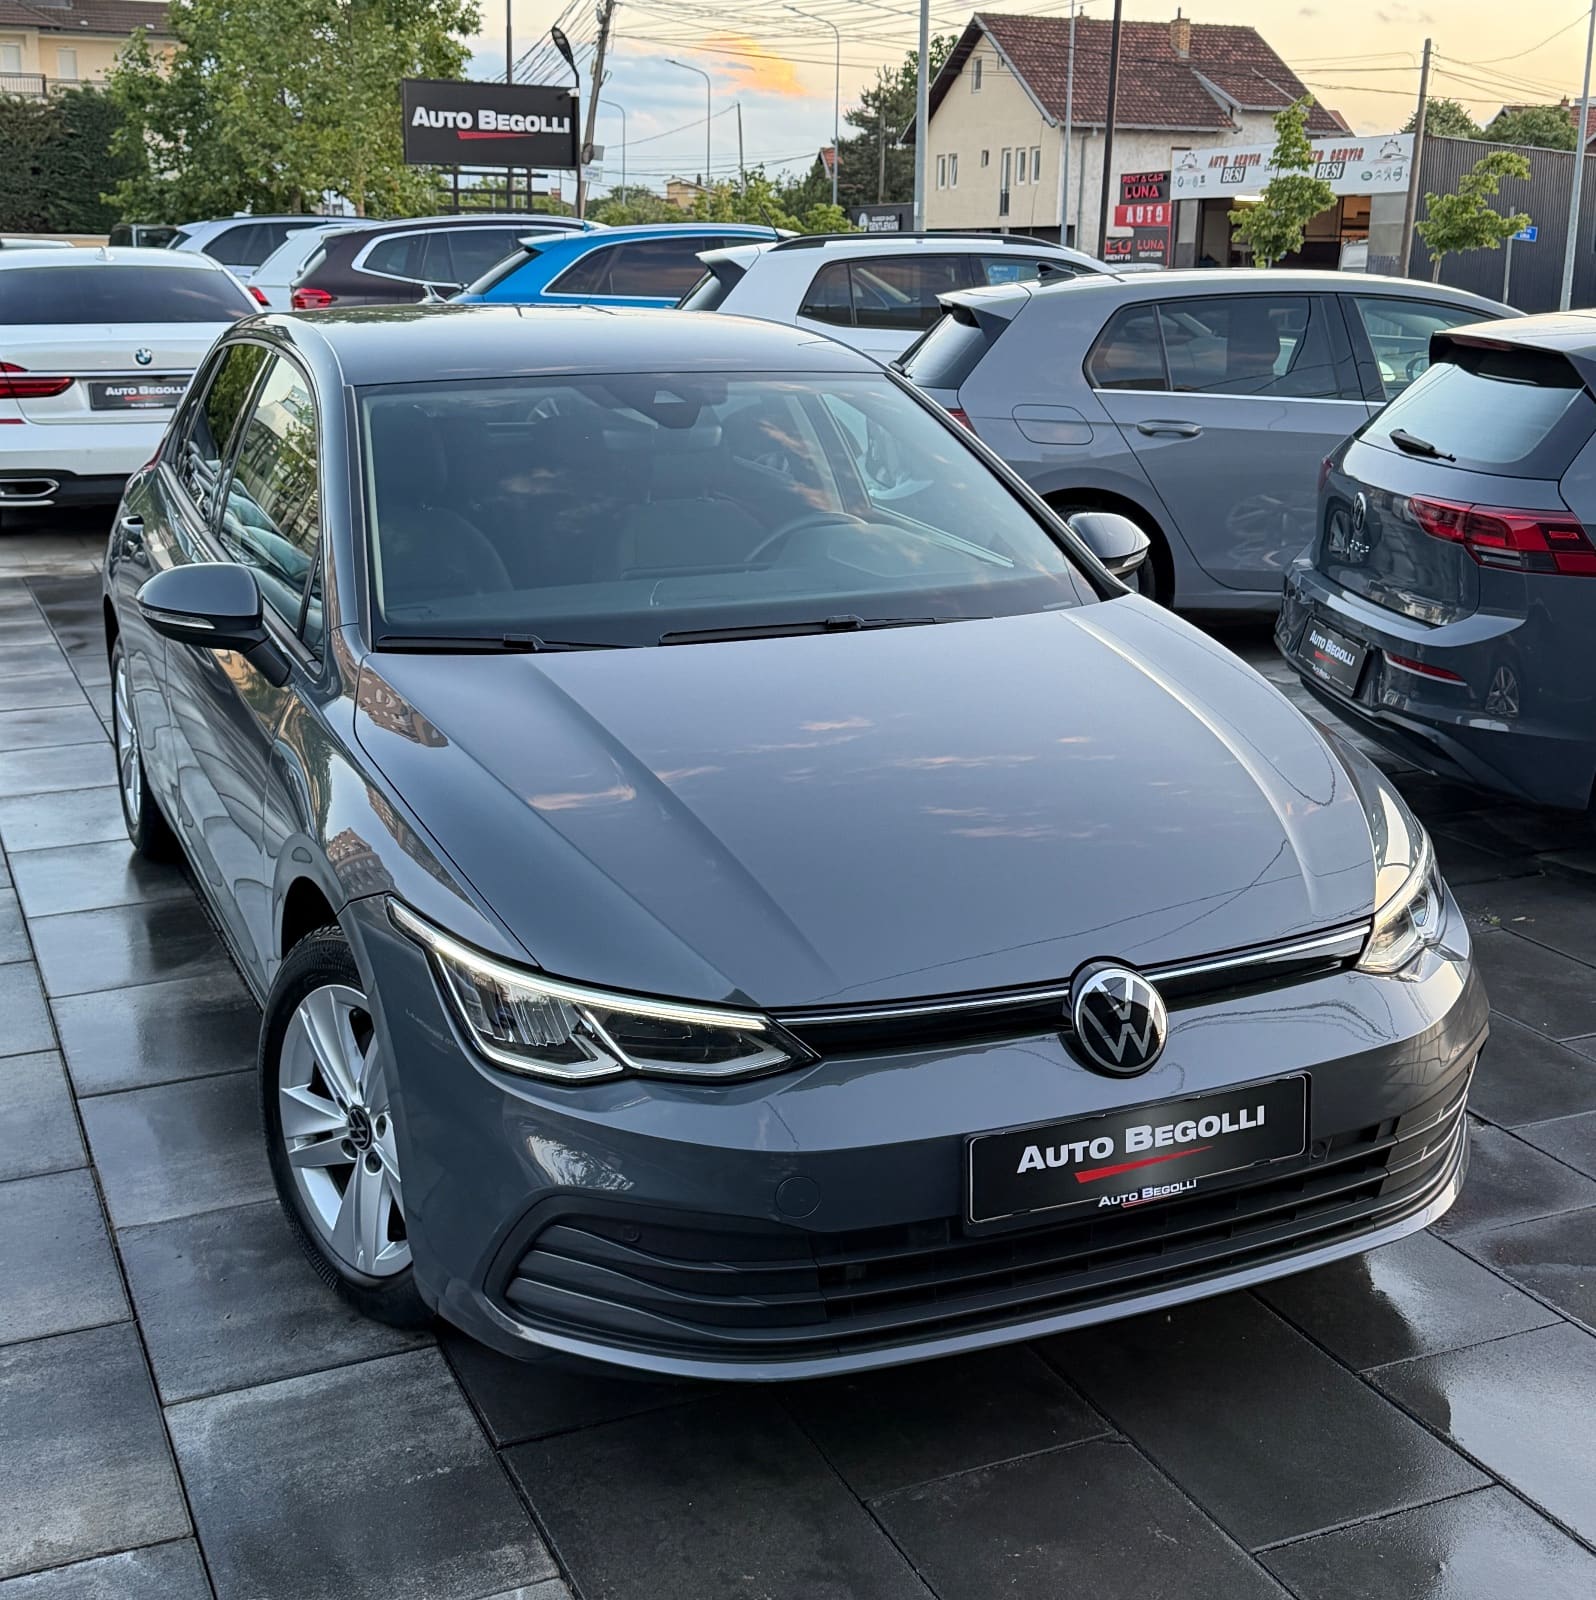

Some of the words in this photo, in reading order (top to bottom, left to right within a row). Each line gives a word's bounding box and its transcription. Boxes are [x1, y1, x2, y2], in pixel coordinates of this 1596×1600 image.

[412, 106, 473, 129] AUTO
[478, 109, 571, 134] BEGOLLI
[1208, 155, 1229, 168] AUTO
[1222, 167, 1244, 183] BESI
[1317, 162, 1343, 179] BESI
[1125, 185, 1160, 200] LUNA
[1126, 206, 1163, 223] AUTO
[1137, 240, 1164, 250] LUNA
[105, 387, 137, 396] AUTO
[1309, 630, 1326, 650] AUTO
[1325, 639, 1356, 666] BEGOLLI
[1016, 1137, 1114, 1174] AUTO
[1125, 1105, 1265, 1154] BEGOLLI
[1098, 1192, 1138, 1207] AUTO
[1141, 1179, 1197, 1198] BEGOLLI
